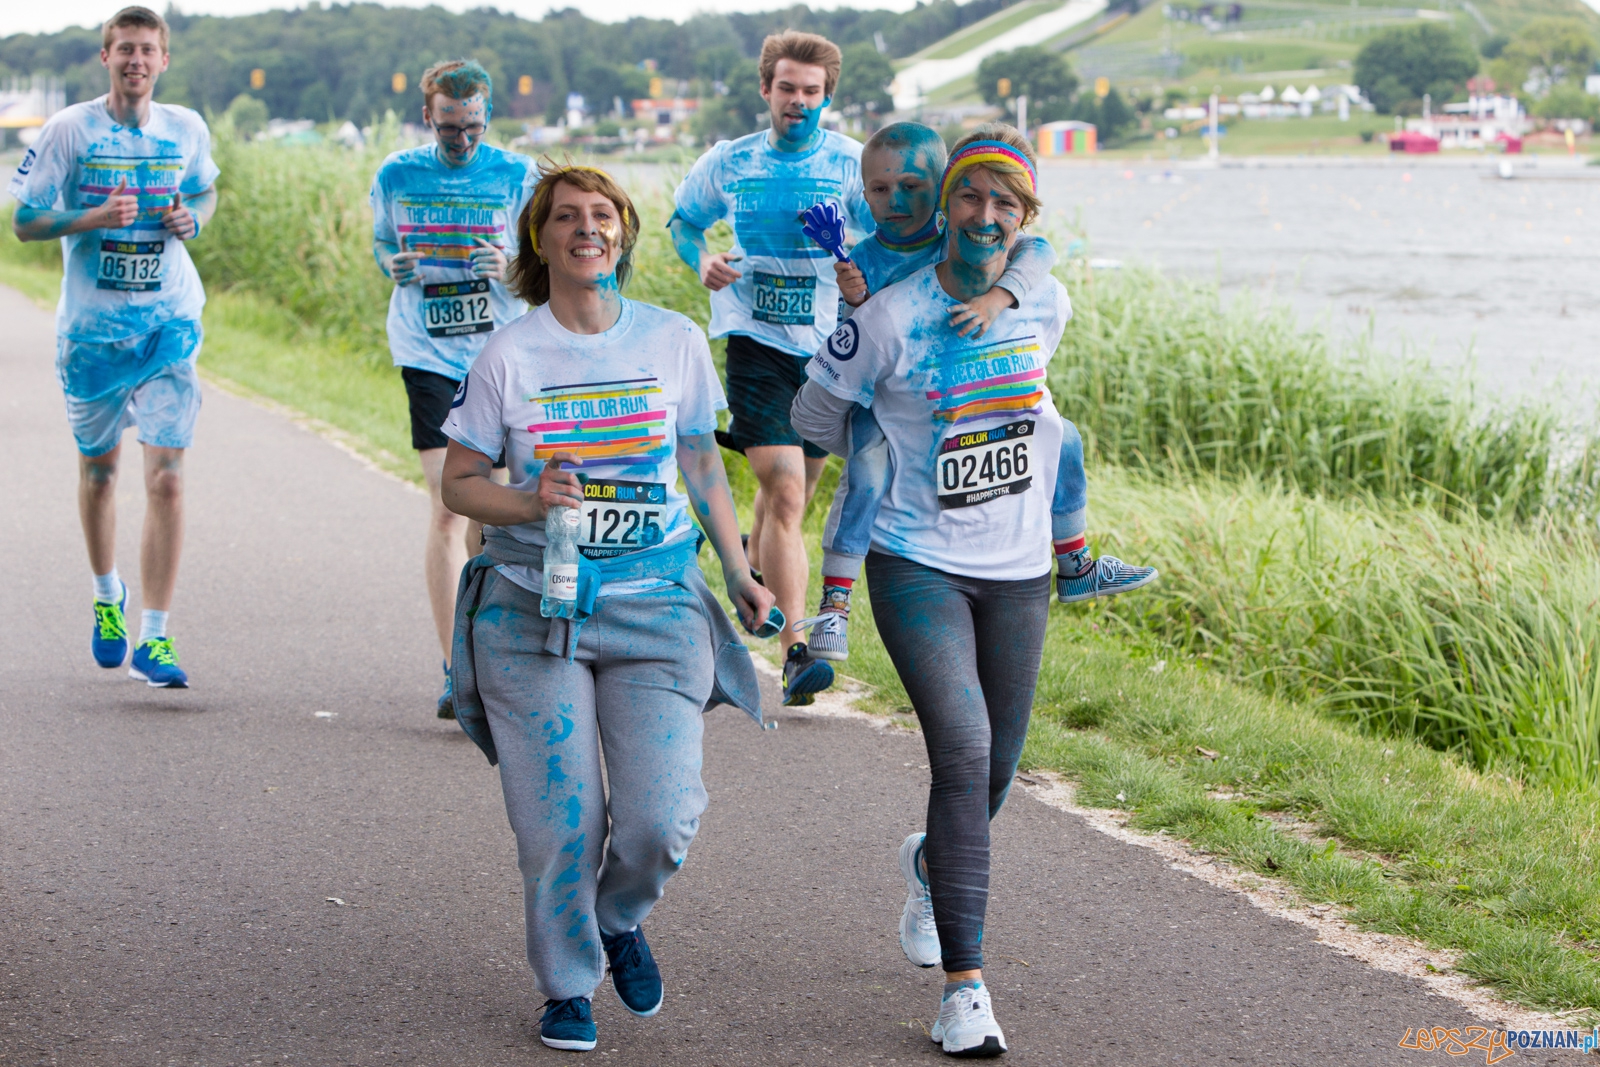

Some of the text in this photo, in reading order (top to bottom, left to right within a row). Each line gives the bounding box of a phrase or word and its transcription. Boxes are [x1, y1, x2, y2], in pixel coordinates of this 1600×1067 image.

[406, 206, 426, 223] THE
[468, 208, 493, 225] RUN
[102, 255, 160, 280] 05132
[429, 297, 489, 325] 03812
[756, 287, 812, 314] 03526
[835, 329, 851, 350] PZU
[814, 351, 841, 381] DROWIE
[1011, 352, 1035, 373] RUN
[542, 395, 649, 420] THE COLOR RUN
[944, 437, 960, 450] THE
[960, 431, 988, 447] COLOR
[988, 428, 1006, 441] RUN
[942, 442, 1028, 491] 02466
[584, 484, 636, 499] COLOR RUN
[966, 486, 1010, 503] #HAPPIEST5K
[587, 508, 660, 545] 1225
